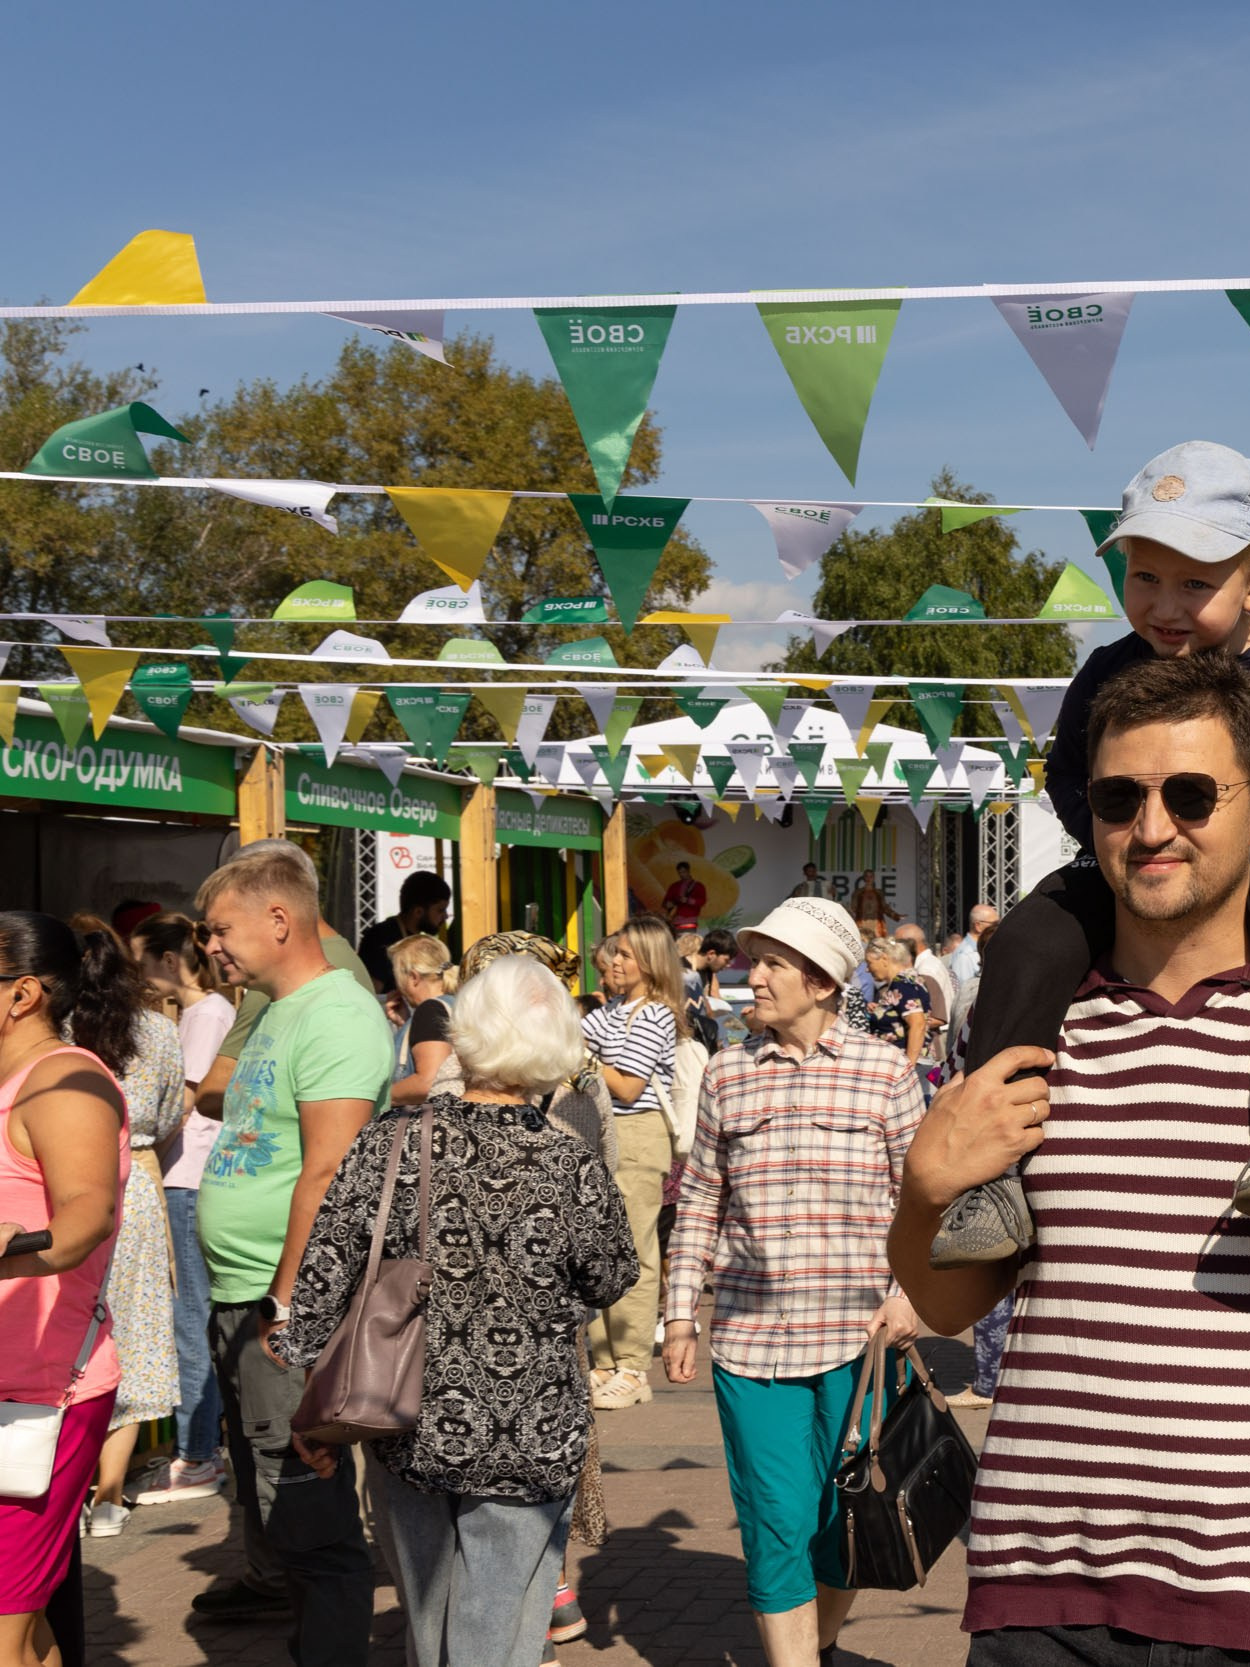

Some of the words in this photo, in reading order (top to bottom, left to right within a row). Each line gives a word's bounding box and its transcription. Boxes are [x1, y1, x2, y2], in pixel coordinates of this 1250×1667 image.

[775, 507, 832, 521] СВОЁ
[612, 516, 665, 528] РСХБ
[544, 602, 582, 611] РСХБ
[2, 738, 183, 792] СКОРОДУМКА
[297, 772, 386, 815] Сливочное
[390, 788, 438, 828] Озеро
